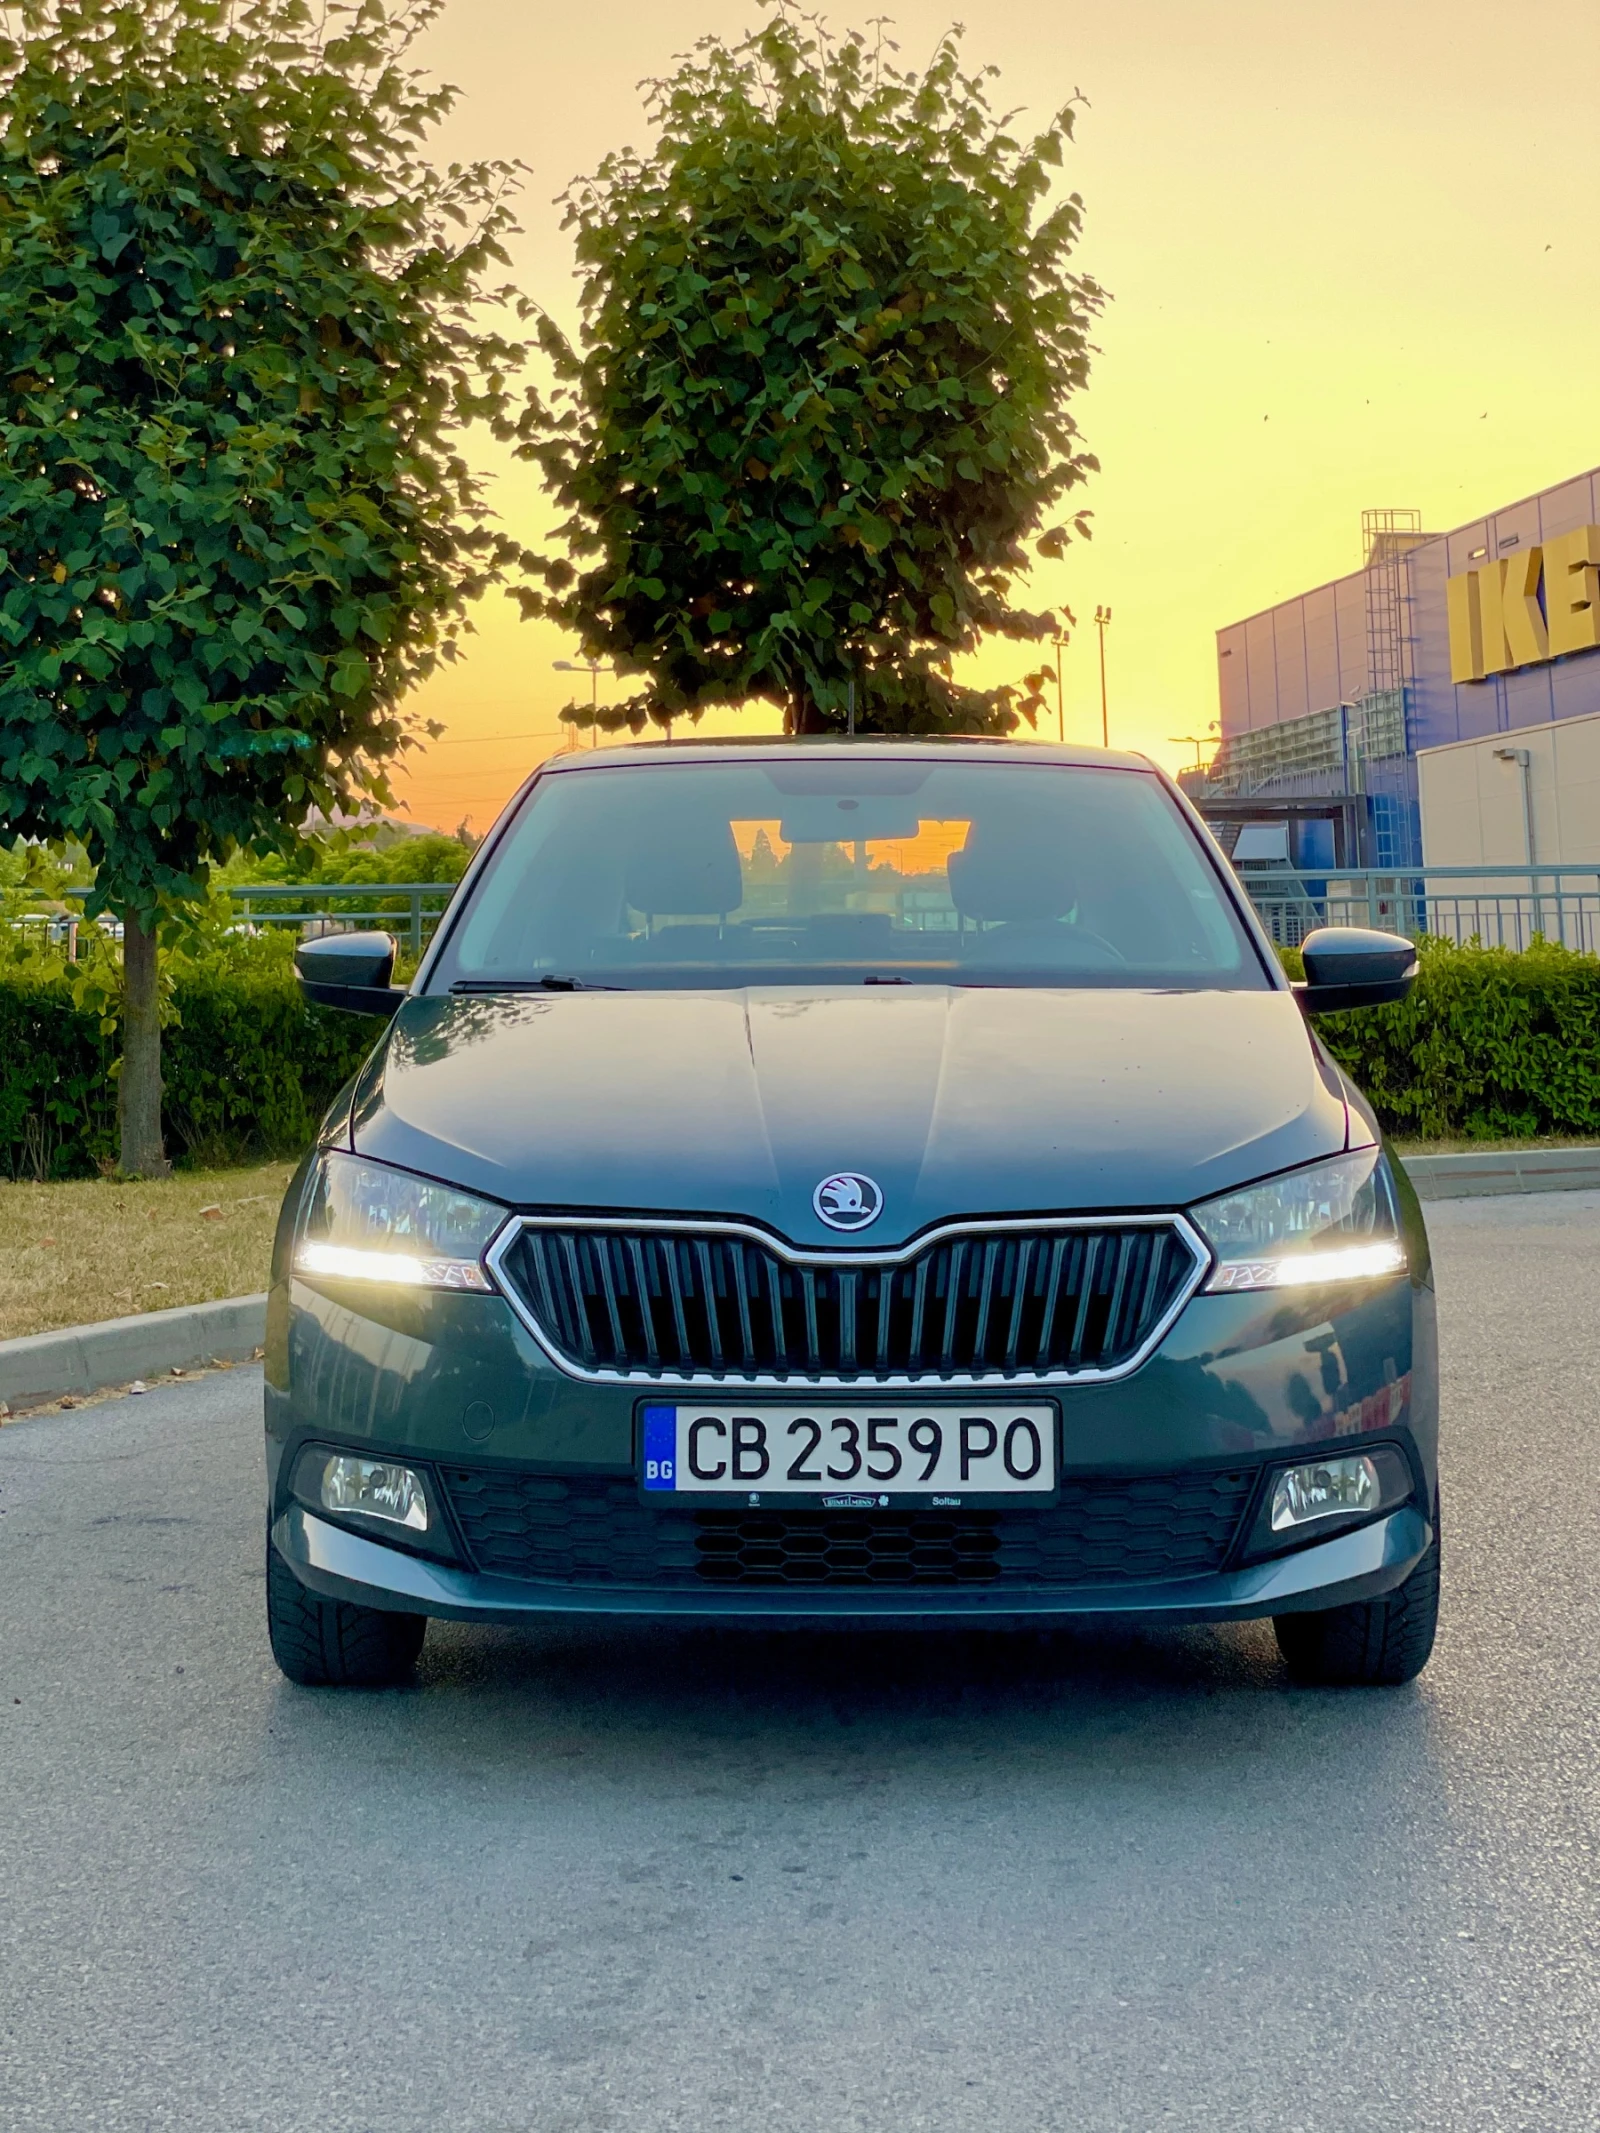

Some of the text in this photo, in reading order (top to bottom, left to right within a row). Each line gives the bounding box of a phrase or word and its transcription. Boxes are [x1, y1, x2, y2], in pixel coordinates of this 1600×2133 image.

[688, 1416, 770, 1481] CB
[786, 1417, 943, 1481] 2359
[646, 1460, 673, 1479] BG
[932, 1496, 961, 1505] Soltau
